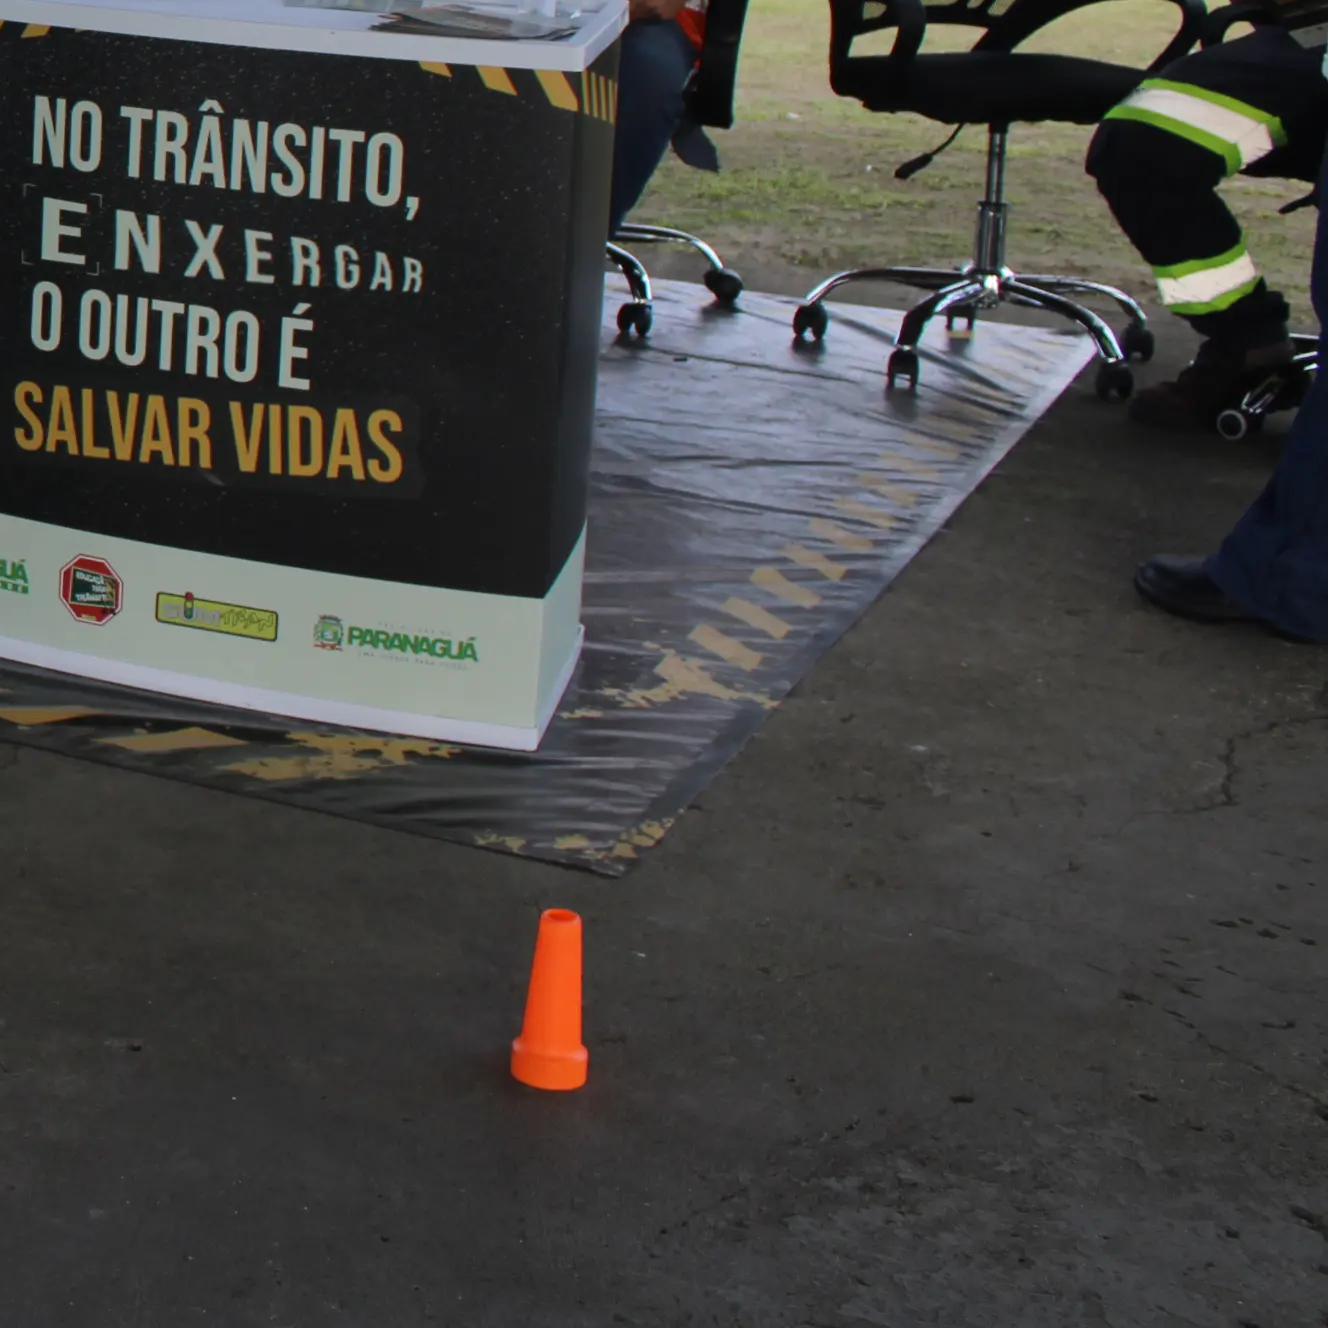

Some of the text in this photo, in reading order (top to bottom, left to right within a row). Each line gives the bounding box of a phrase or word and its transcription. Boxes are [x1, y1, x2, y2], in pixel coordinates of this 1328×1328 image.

[32, 94, 420, 221] NO TRÂNSITO,
[41, 197, 424, 294] ENXERGAR
[30, 281, 315, 391] O OUTRO É
[13, 380, 404, 483] SALVAR VIDAS
[347, 625, 480, 663] PARANAGUÁ
